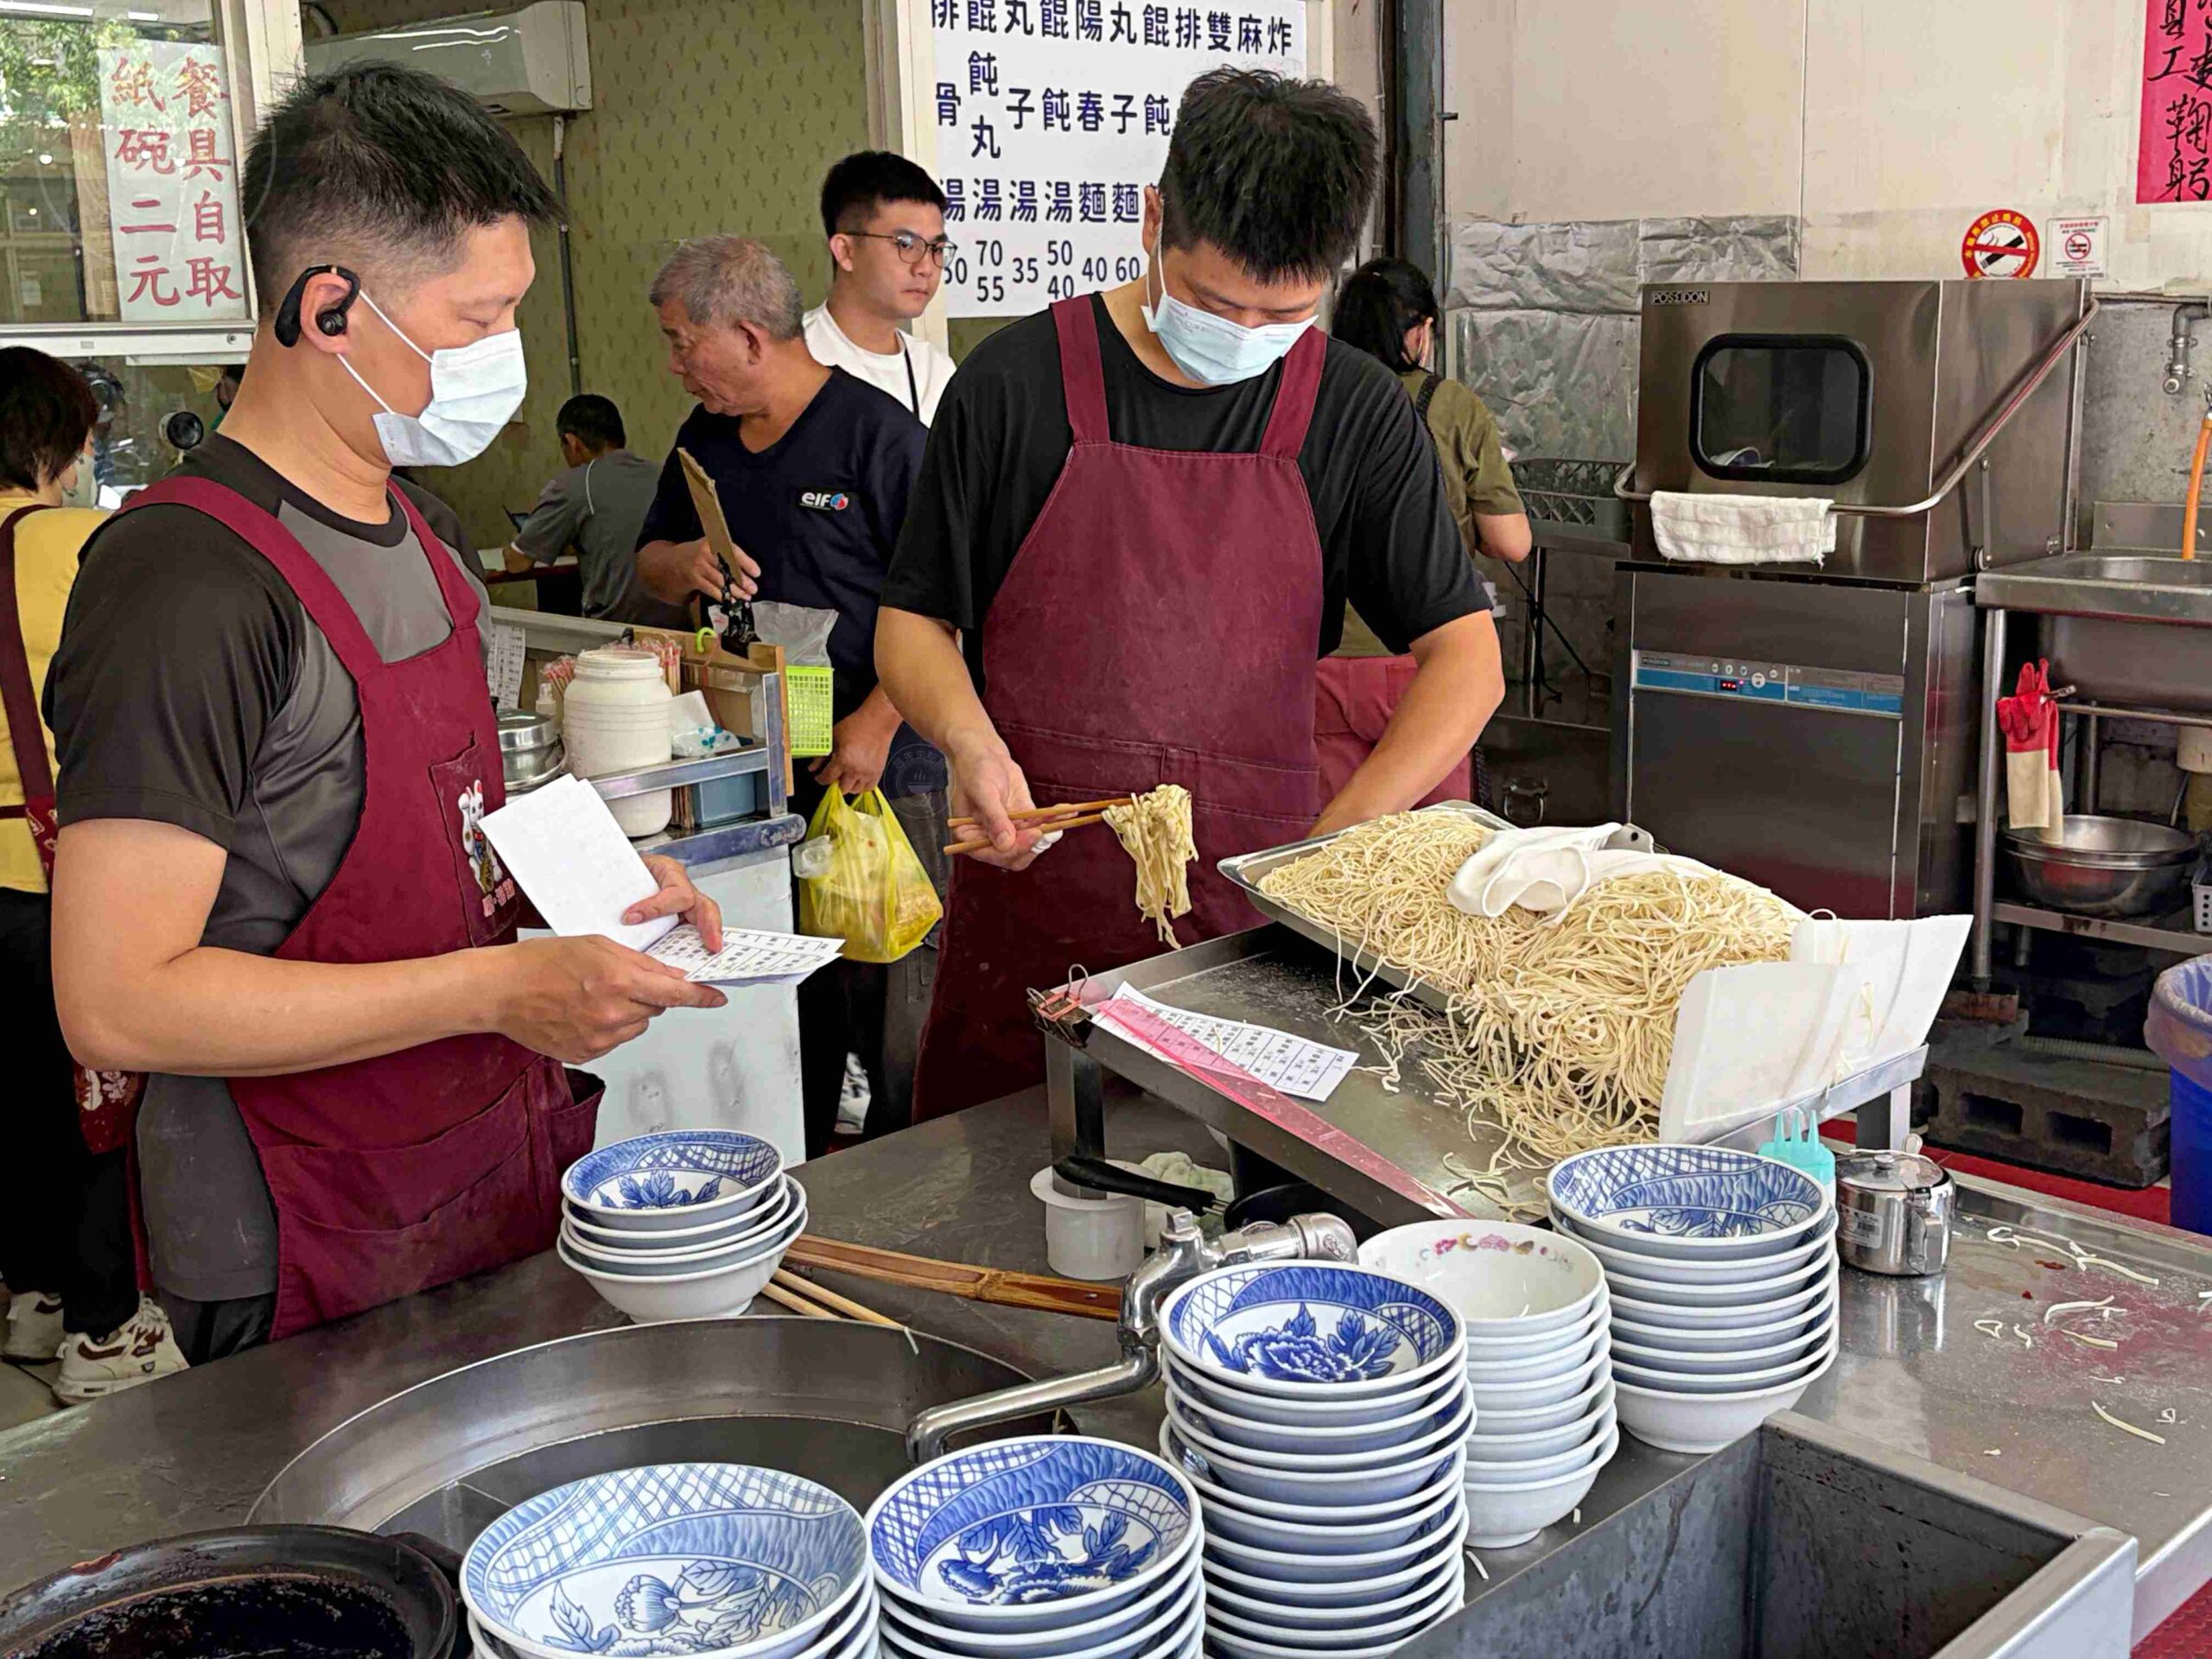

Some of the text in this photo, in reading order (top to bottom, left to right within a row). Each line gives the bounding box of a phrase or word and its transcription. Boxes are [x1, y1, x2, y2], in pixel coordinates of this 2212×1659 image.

[1174, 6, 1202, 50] 排
[1236, 13, 1263, 55] 麻
[1268, 16, 1293, 57] 炸
[111, 57, 181, 307] 紙碗二元
[172, 55, 243, 308] 餐具自取
[976, 240, 1003, 266] 70
[1046, 240, 1073, 266] 50
[1012, 257, 1039, 283] 35
[1081, 257, 1108, 283] 40
[1115, 257, 1141, 282] 60
[976, 276, 1004, 302] 55
[1047, 275, 1075, 301] 40
[1652, 291, 1708, 304] POSEIDON
[801, 492, 831, 507] elf
